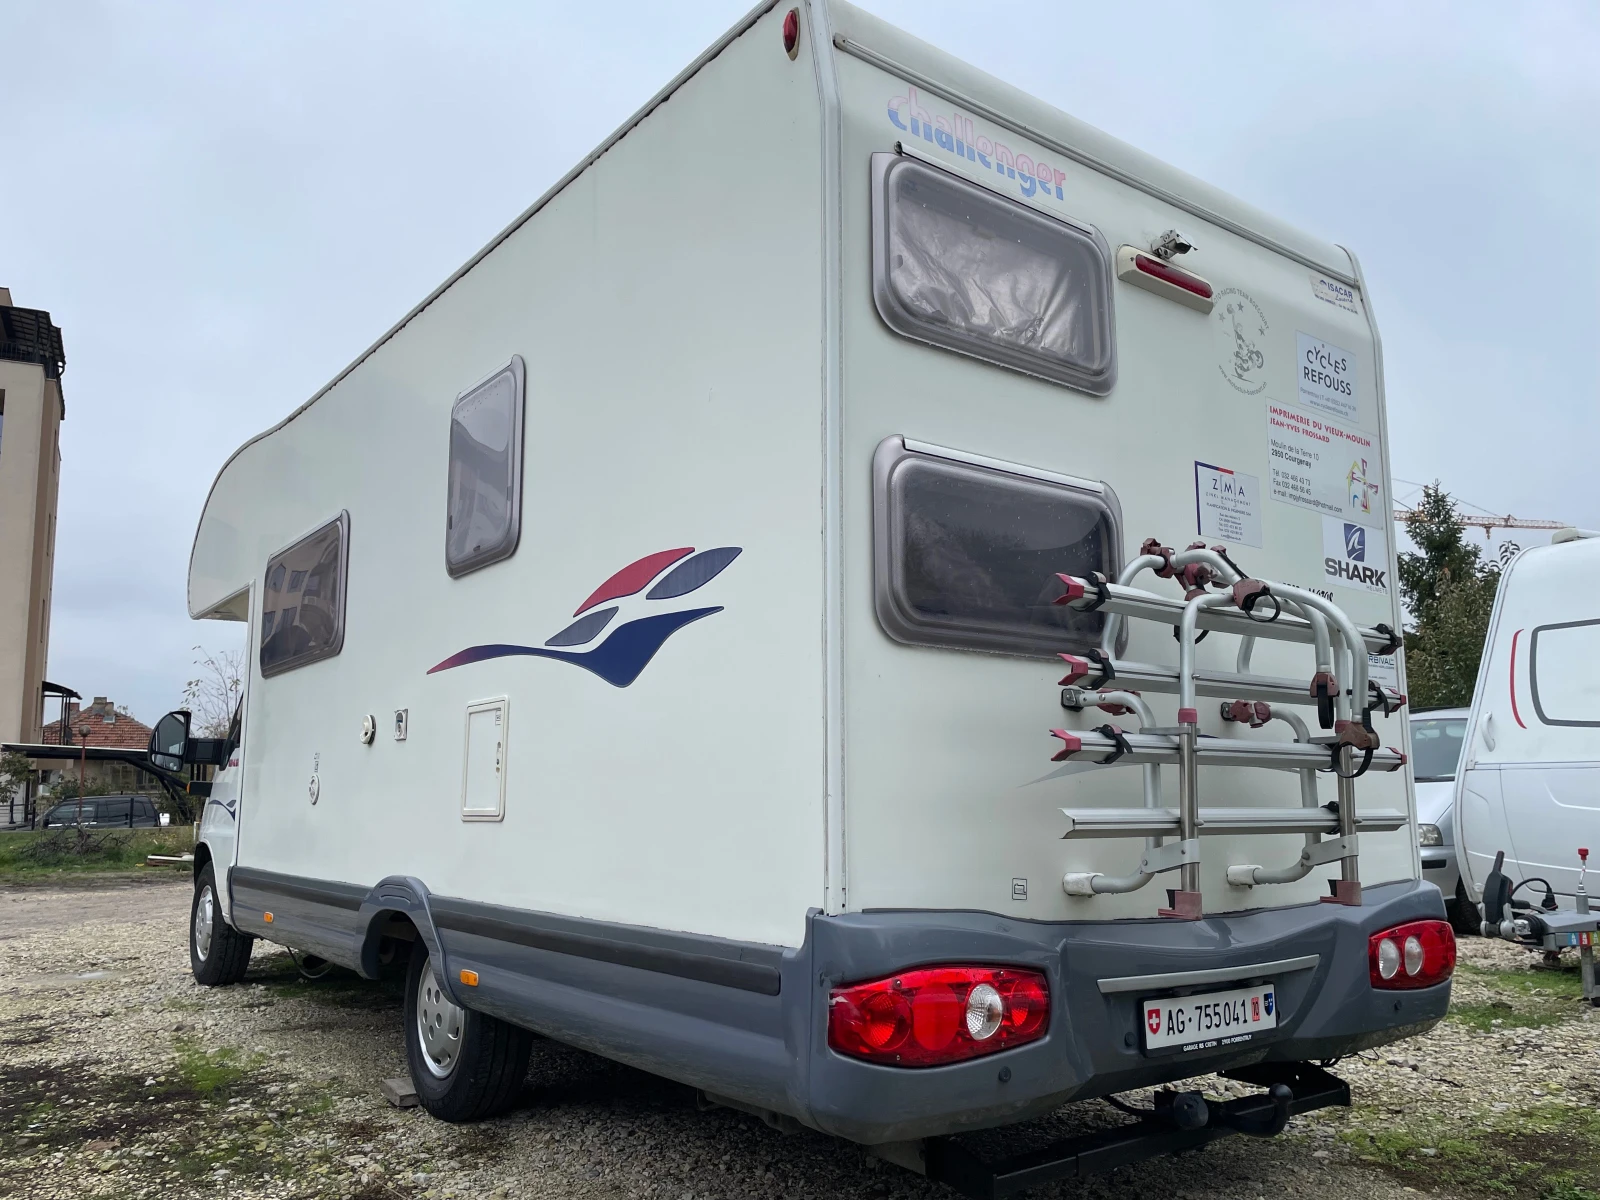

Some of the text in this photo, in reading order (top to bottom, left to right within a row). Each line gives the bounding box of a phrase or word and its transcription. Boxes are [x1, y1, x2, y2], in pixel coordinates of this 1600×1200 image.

[887, 86, 1066, 201] challenger
[1237, 288, 1249, 301] TEAM
[1328, 282, 1353, 300] ISACAR
[1306, 346, 1347, 375] CYCLES
[1303, 366, 1352, 396] REFOUSS
[1270, 406, 1371, 447] IMPRIMERIE DU VIEUX-MOULIN
[1270, 418, 1330, 442] JEAN-YVES FROSSARD
[1271, 439, 1287, 449] Moulin
[1300, 448, 1312, 458] Terre
[1272, 448, 1312, 468] 2950 Courgenay
[1273, 478, 1281, 486] Fax
[1325, 558, 1386, 588] SHARK
[1366, 584, 1388, 594] HELMETS
[1183, 1044, 1198, 1052] GARAGE
